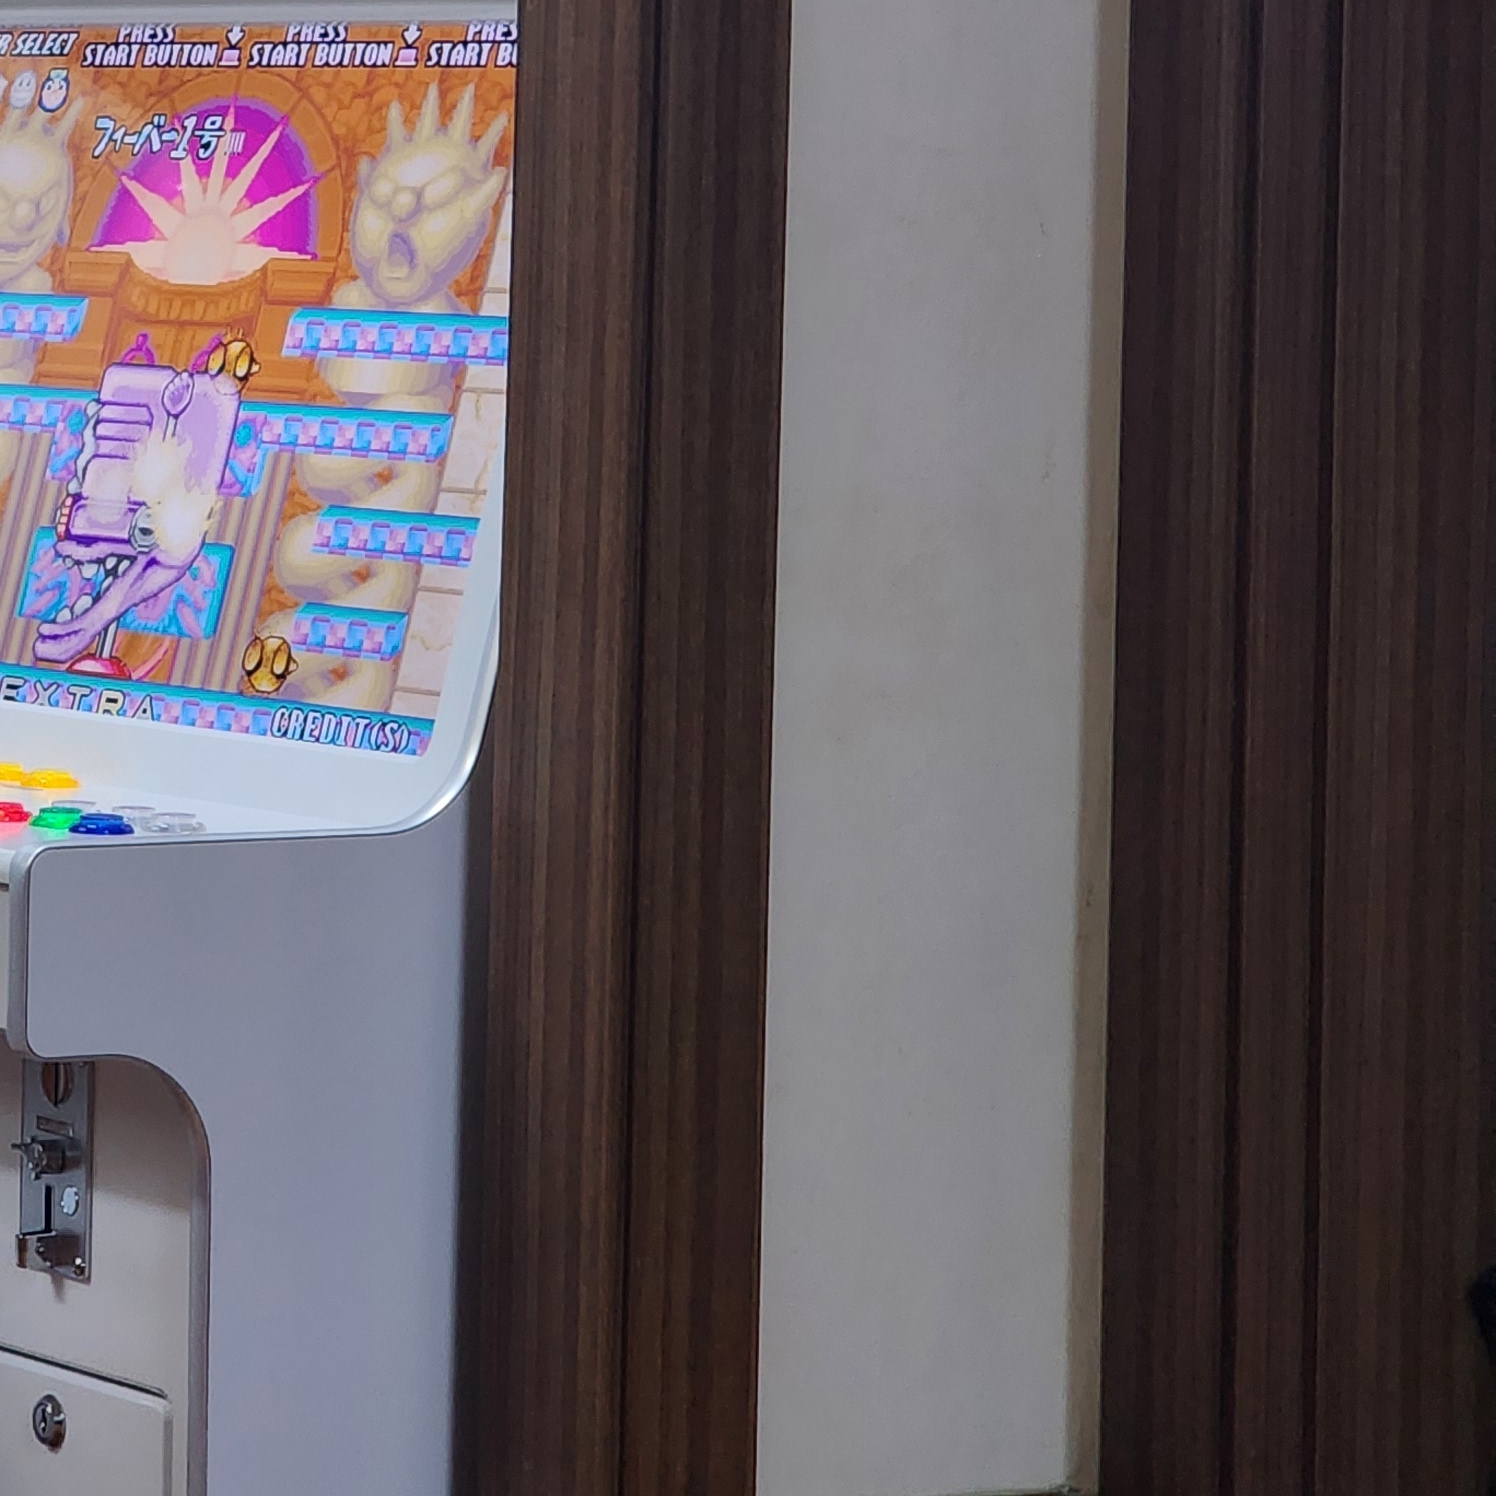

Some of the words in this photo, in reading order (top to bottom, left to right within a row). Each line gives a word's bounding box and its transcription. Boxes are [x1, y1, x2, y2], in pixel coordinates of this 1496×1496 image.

[12, 32, 79, 56] SELECT
[118, 24, 176, 42] PRESS
[286, 23, 348, 42] PRESS
[82, 43, 140, 67] START
[142, 43, 218, 67] BUTTON
[248, 43, 313, 67] START
[313, 43, 394, 67] BUTTON
[425, 43, 494, 67] START
[271, 706, 411, 754] CREDIT(S)
